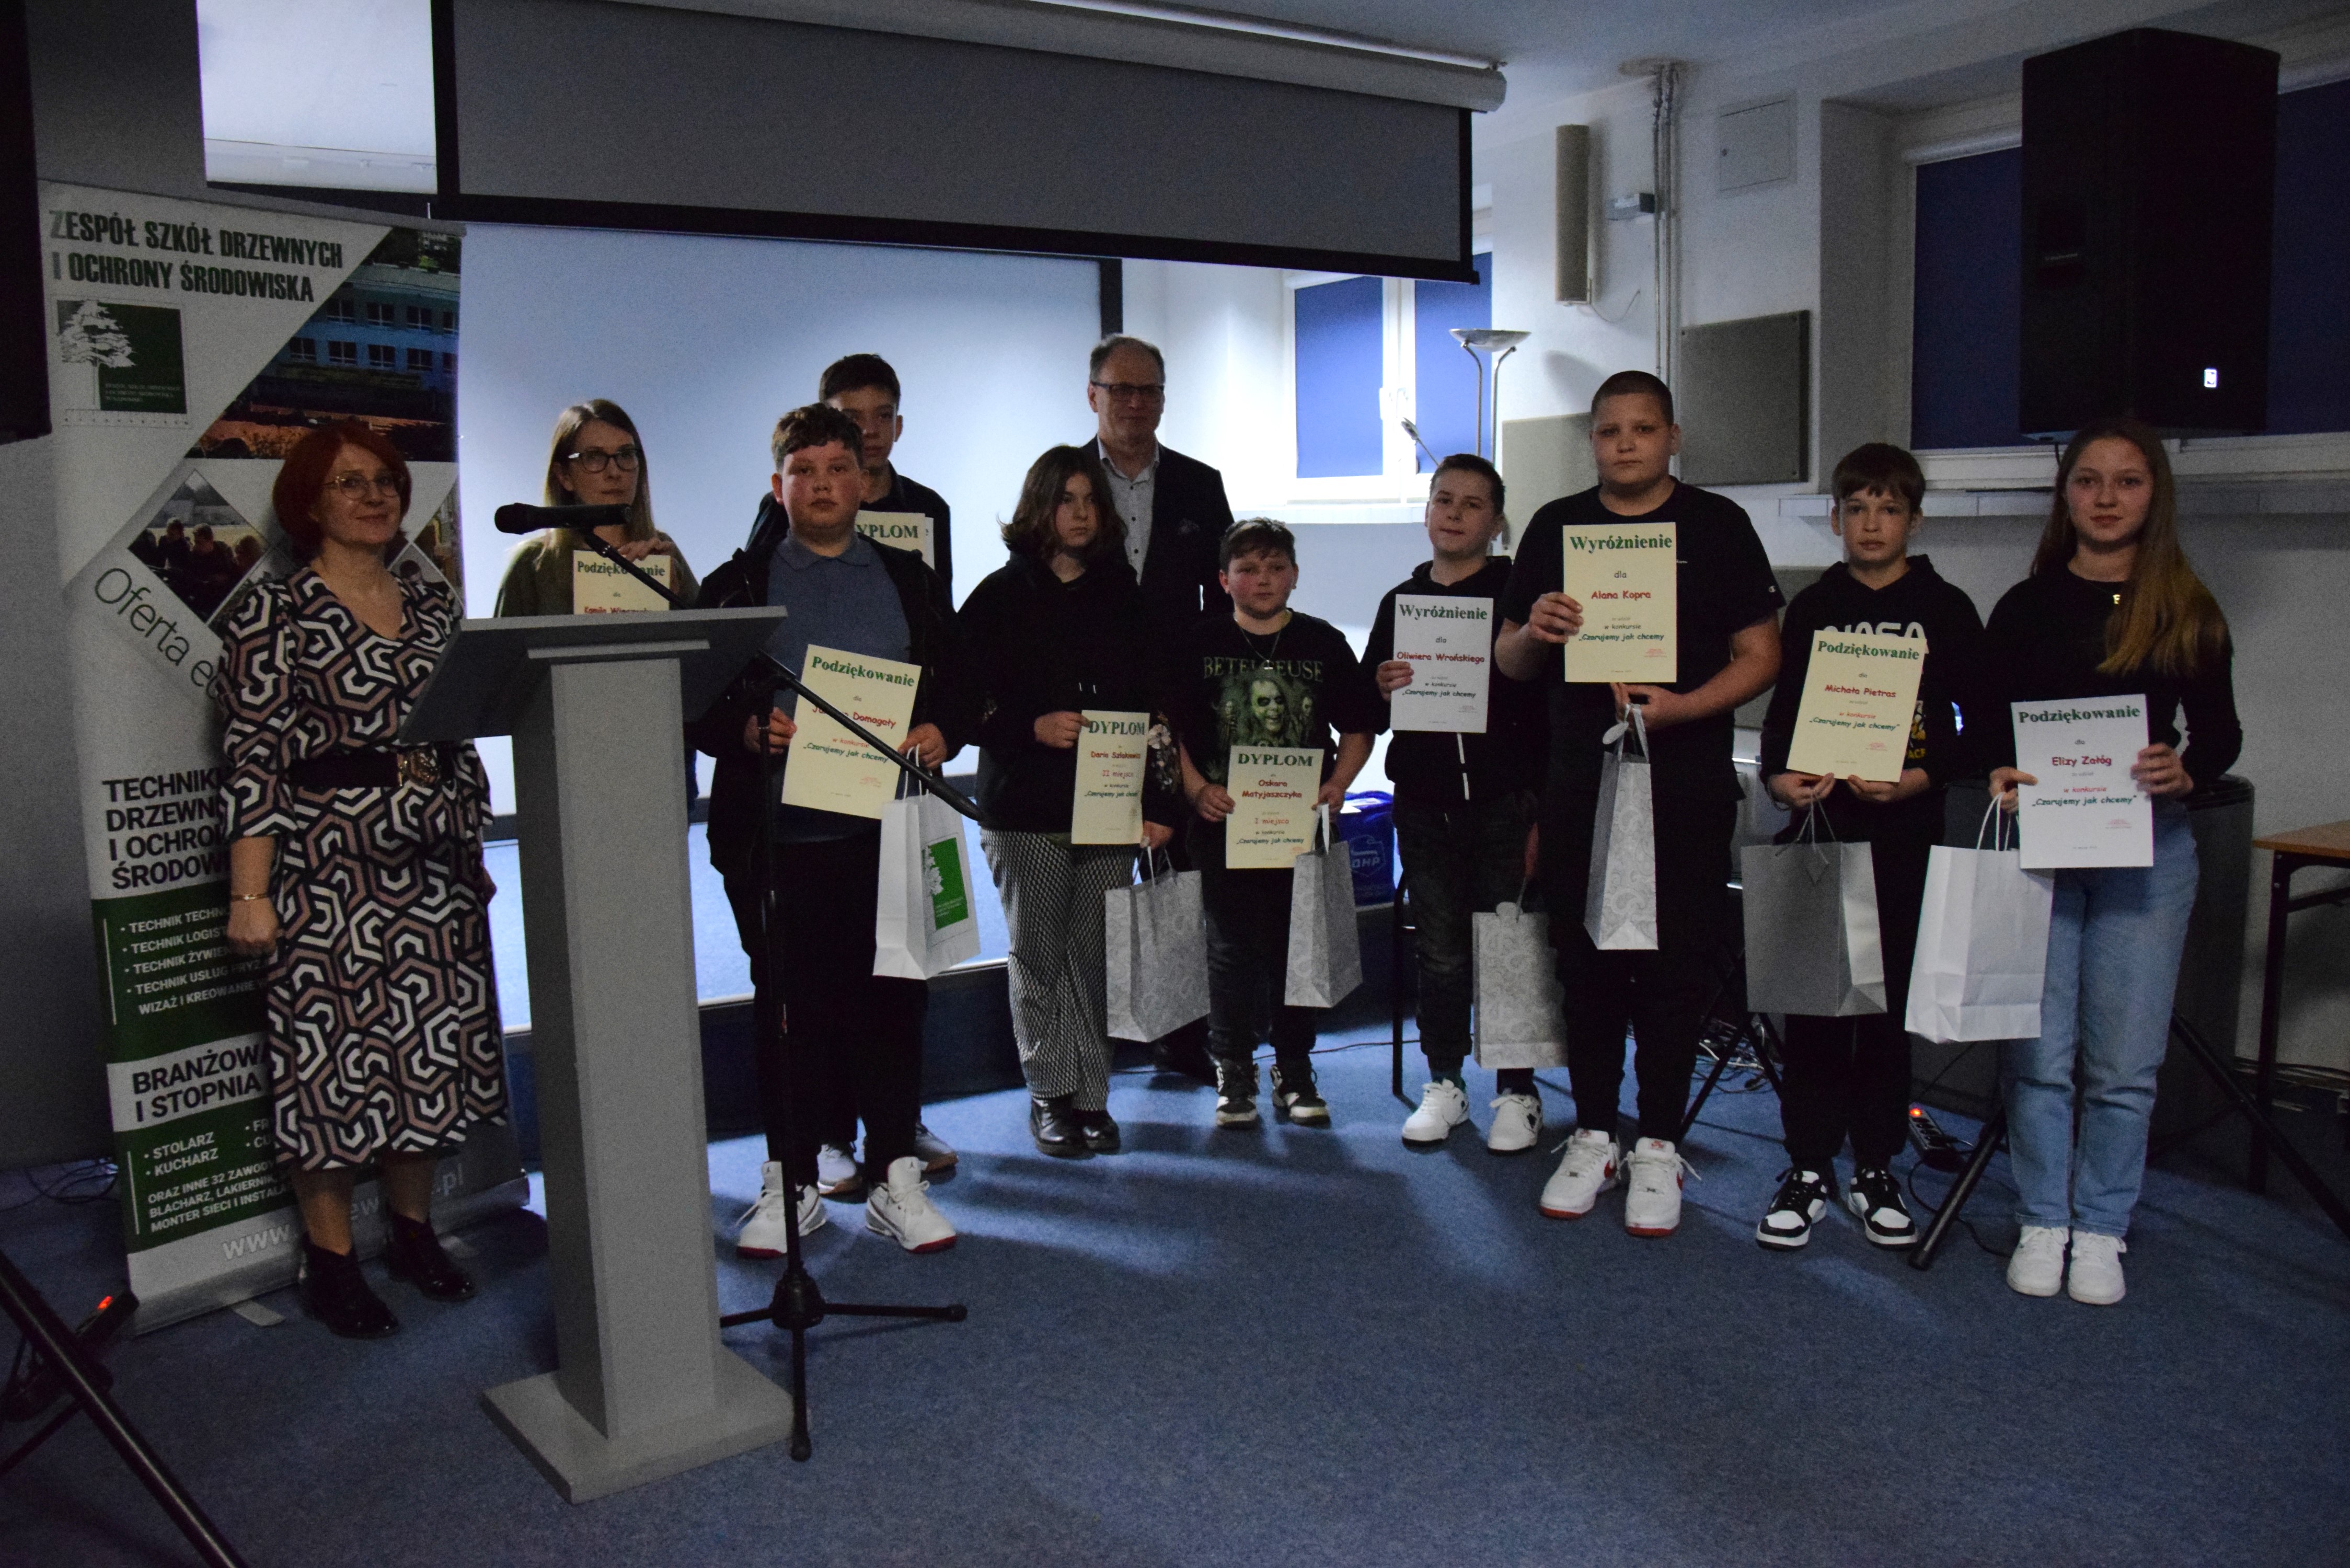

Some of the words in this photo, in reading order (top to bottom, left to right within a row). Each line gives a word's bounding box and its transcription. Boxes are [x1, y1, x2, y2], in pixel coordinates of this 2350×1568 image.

[49, 210, 139, 247] ZESPÓŁ
[144, 221, 214, 255] SZKÓŁ
[220, 229, 342, 268] DRZEWNYCH
[53, 251, 61, 280] I
[68, 252, 173, 289] OCHRONY
[180, 260, 314, 302] ŚRODOWISKA
[1570, 534, 1673, 554] Wyróżnienie
[1614, 570, 1627, 579] dla
[1591, 591, 1618, 599] Alana
[1623, 590, 1651, 601] Kopra
[94, 567, 192, 666] Oferta
[1399, 603, 1488, 620] Wyróżnienie
[1621, 633, 1634, 642] jak
[1397, 651, 1432, 661] Oliwiera
[1436, 653, 1485, 664] Wrońskiego
[1817, 640, 1920, 660] Podziękowanie
[811, 655, 915, 687] Podziękowanie
[1825, 684, 1860, 695] Michała
[1863, 687, 1896, 698] Pietras
[1846, 711, 1877, 720] konkursie
[2018, 706, 2141, 724] Podziękowanie
[1088, 720, 1145, 735] DYPLOM
[1852, 720, 1866, 729] jak
[846, 750, 859, 758] jak
[1238, 753, 1313, 767] DYPLOM
[2052, 756, 2077, 767] Elizy
[2083, 797, 2098, 806] jak
[109, 838, 118, 861] I
[129, 917, 183, 934] TECHNIK
[131, 936, 185, 954] TECHNIK
[133, 955, 187, 975] TECHNIK
[134, 975, 188, 995] TECHNIK
[138, 995, 178, 1016] WIZAŻ
[180, 995, 185, 1007] I
[186, 980, 255, 1004] KREOWANIE
[135, 1101, 144, 1122] I
[151, 1074, 262, 1119] STOPNIA
[153, 1131, 215, 1160] STOLARZ
[154, 1148, 220, 1177] KUCHARZ
[147, 1186, 181, 1204] ORAZ
[182, 1178, 210, 1194] INNE
[212, 1172, 225, 1185] 32
[151, 1210, 201, 1233] MONTER
[202, 1201, 231, 1216] SIECI
[233, 1197, 238, 1208] I
